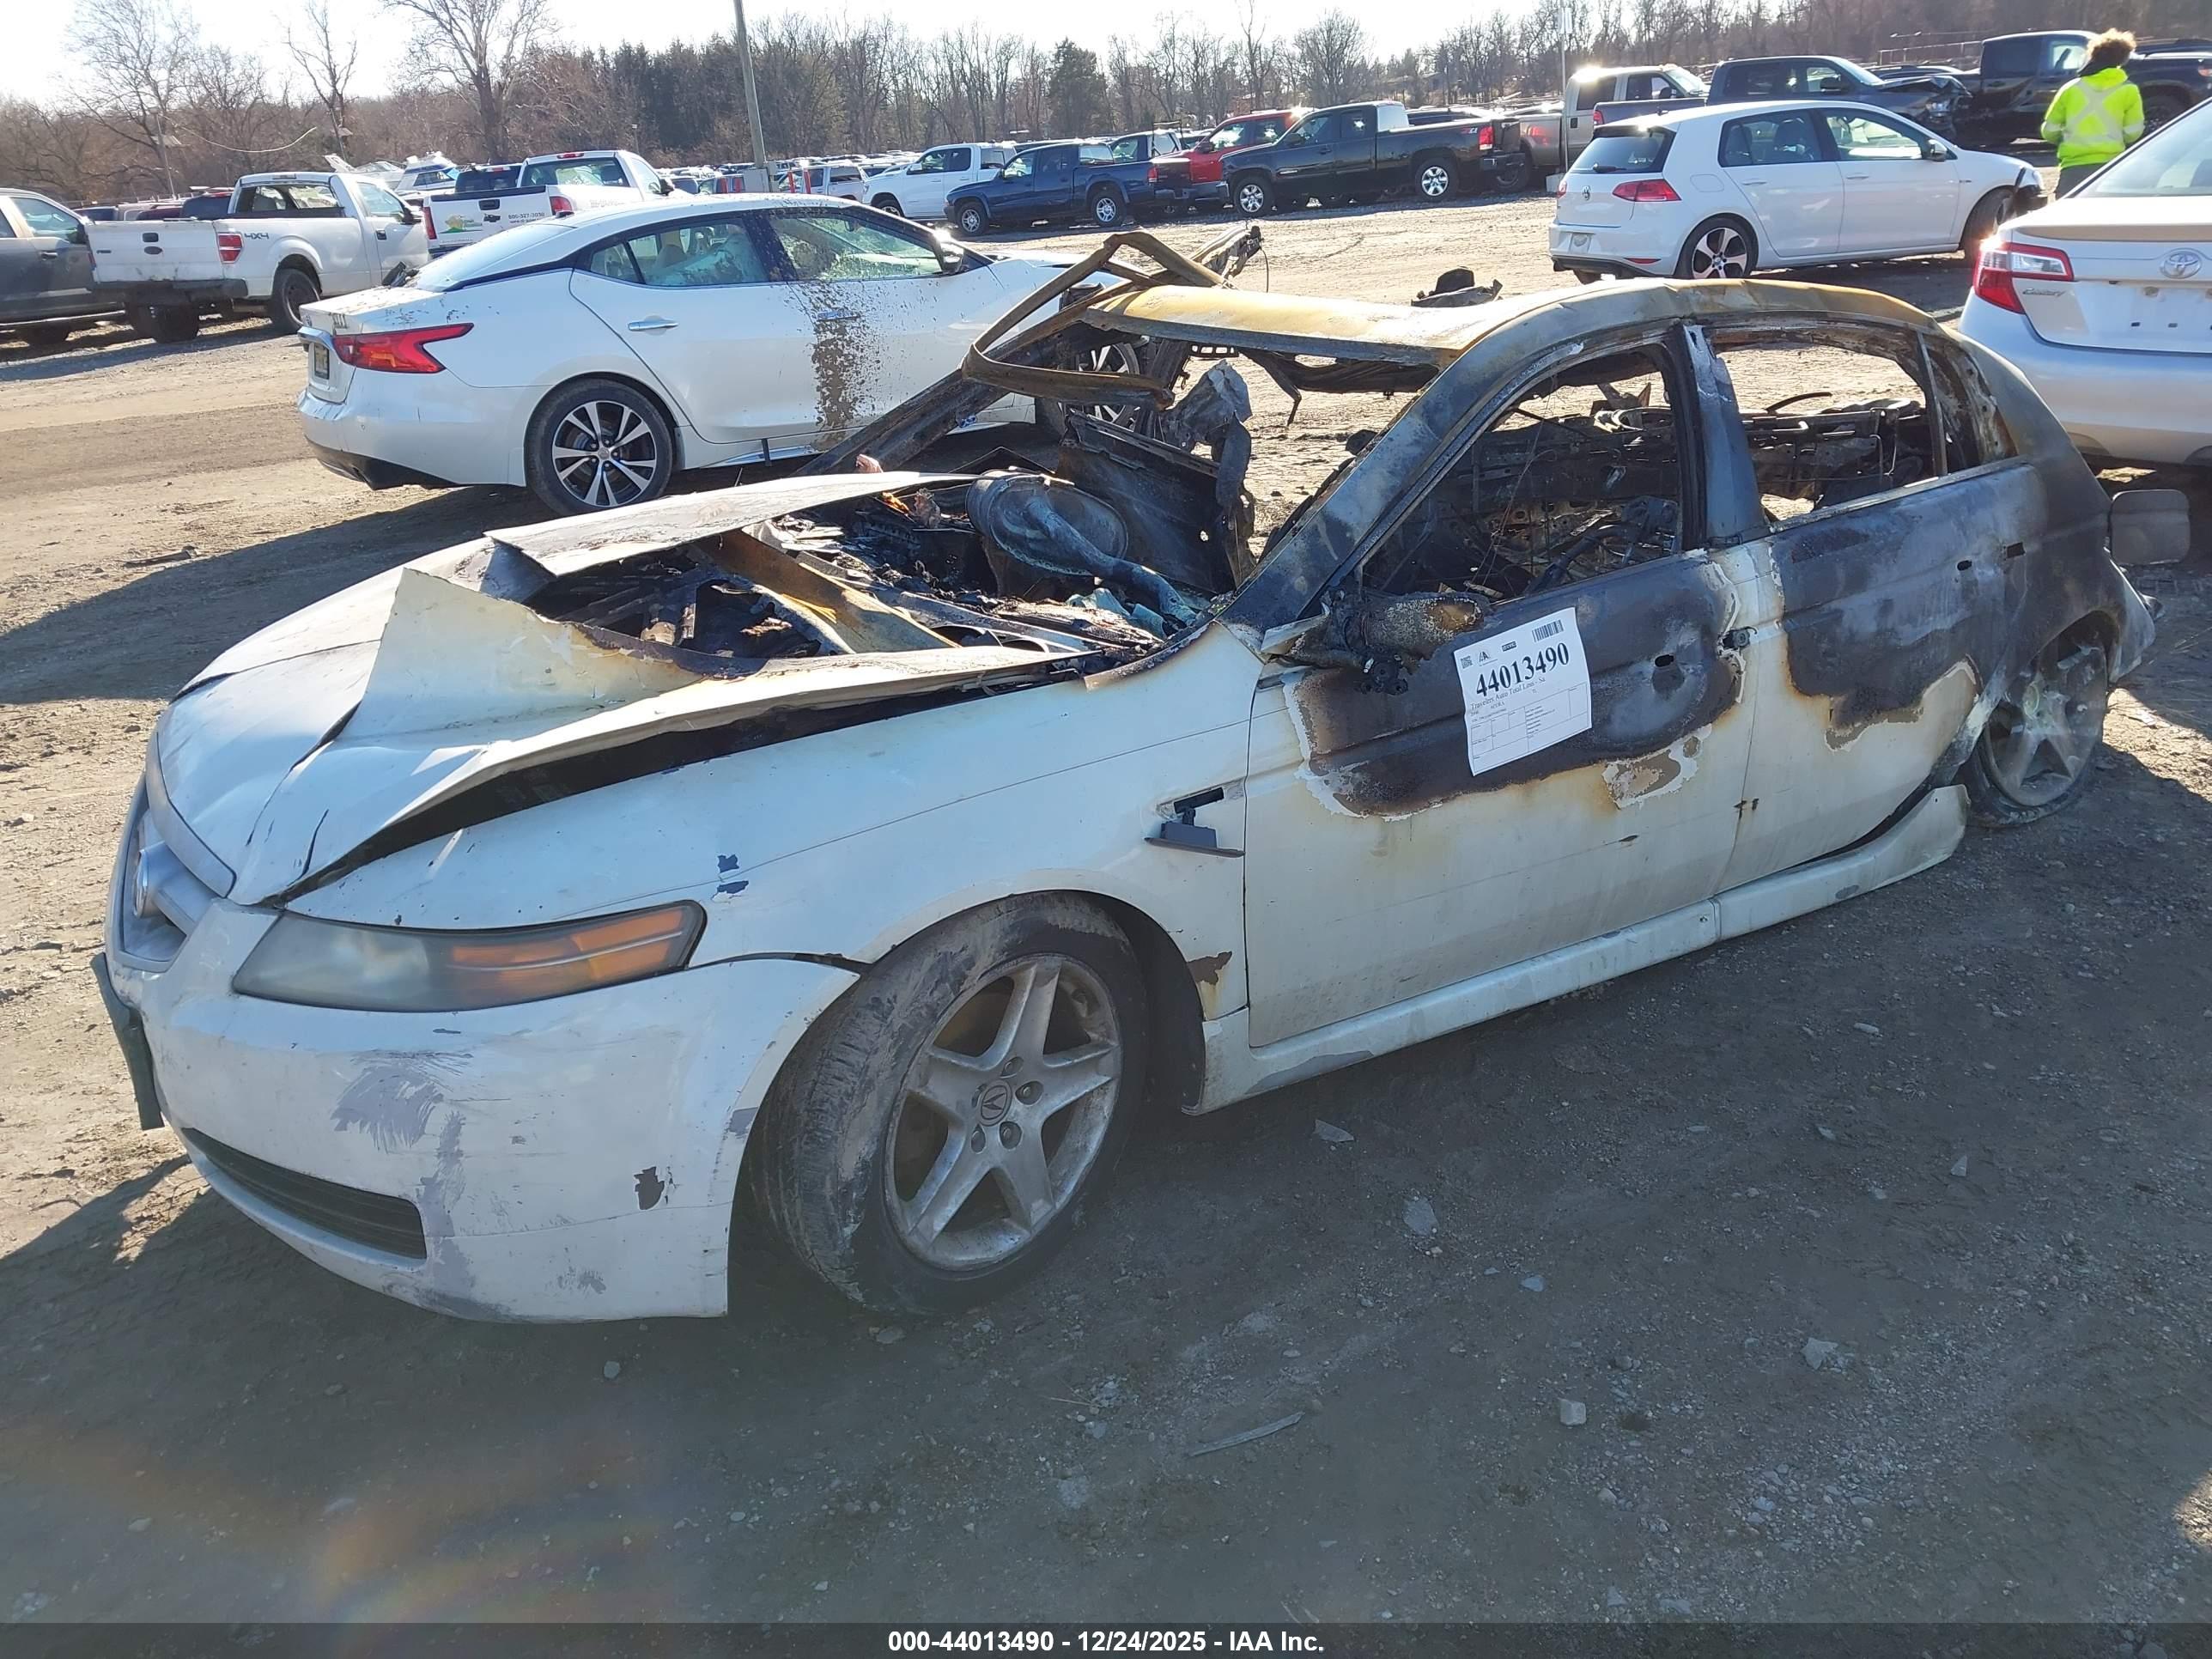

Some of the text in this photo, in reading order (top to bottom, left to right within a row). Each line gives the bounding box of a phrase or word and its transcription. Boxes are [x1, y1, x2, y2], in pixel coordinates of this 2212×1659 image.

[1475, 642, 1570, 697] 44013490
[1471, 697, 1495, 709] Travelers
[1495, 690, 1509, 701] Auto
[1510, 684, 1522, 695] Total
